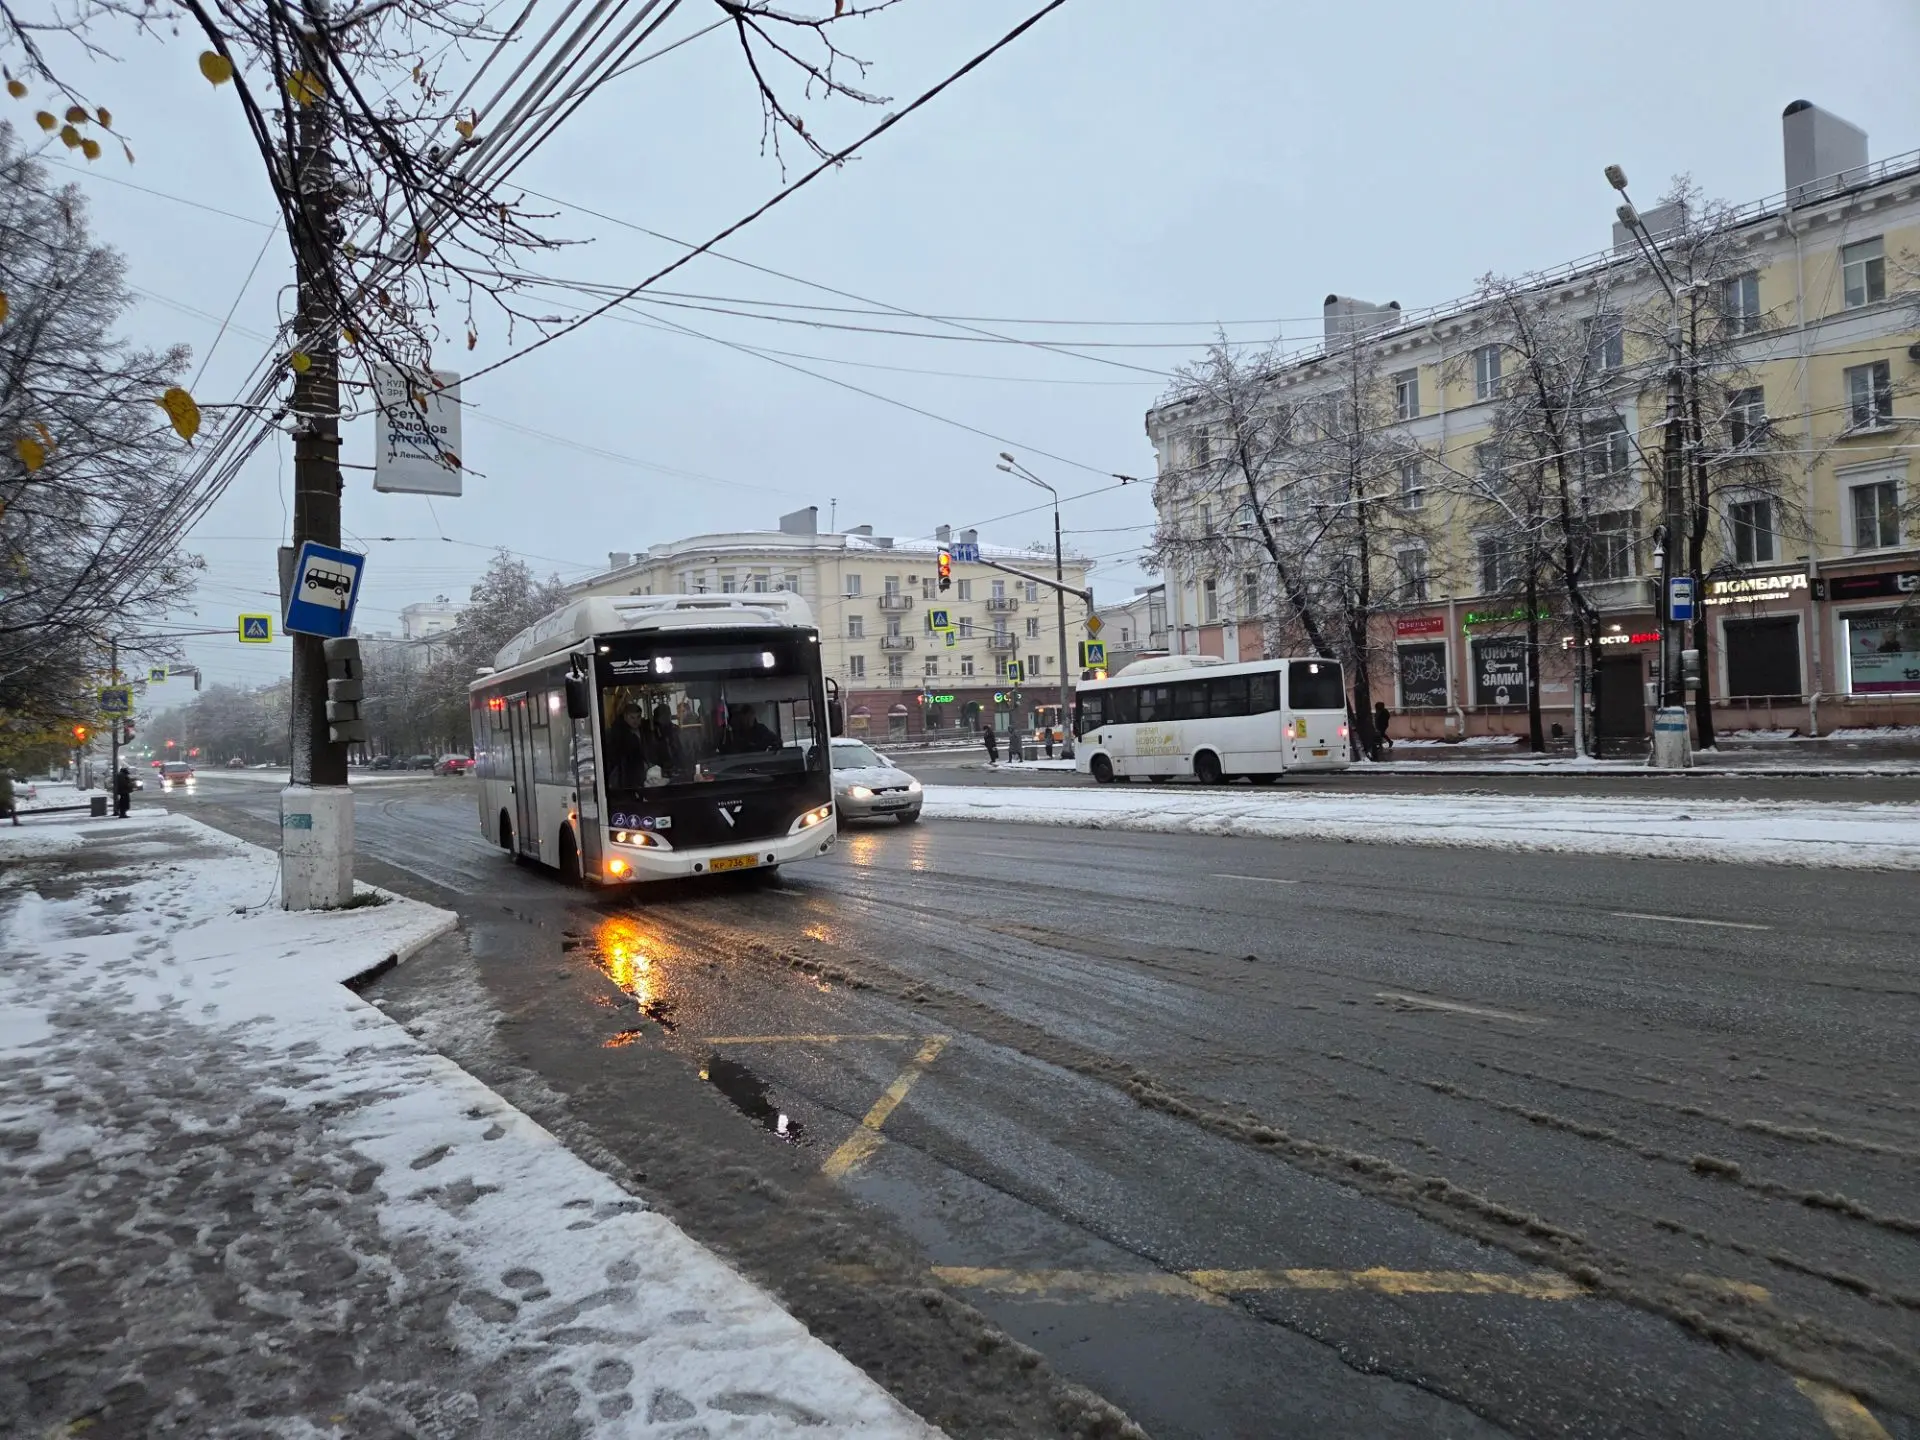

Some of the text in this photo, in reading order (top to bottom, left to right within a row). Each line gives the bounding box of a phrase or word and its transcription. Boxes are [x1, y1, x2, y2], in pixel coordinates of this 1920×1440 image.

[1713, 573, 1808, 594] ЛОМБАРД
[1482, 672, 1524, 687] ЗАМКИ
[728, 859, 744, 868] 736
